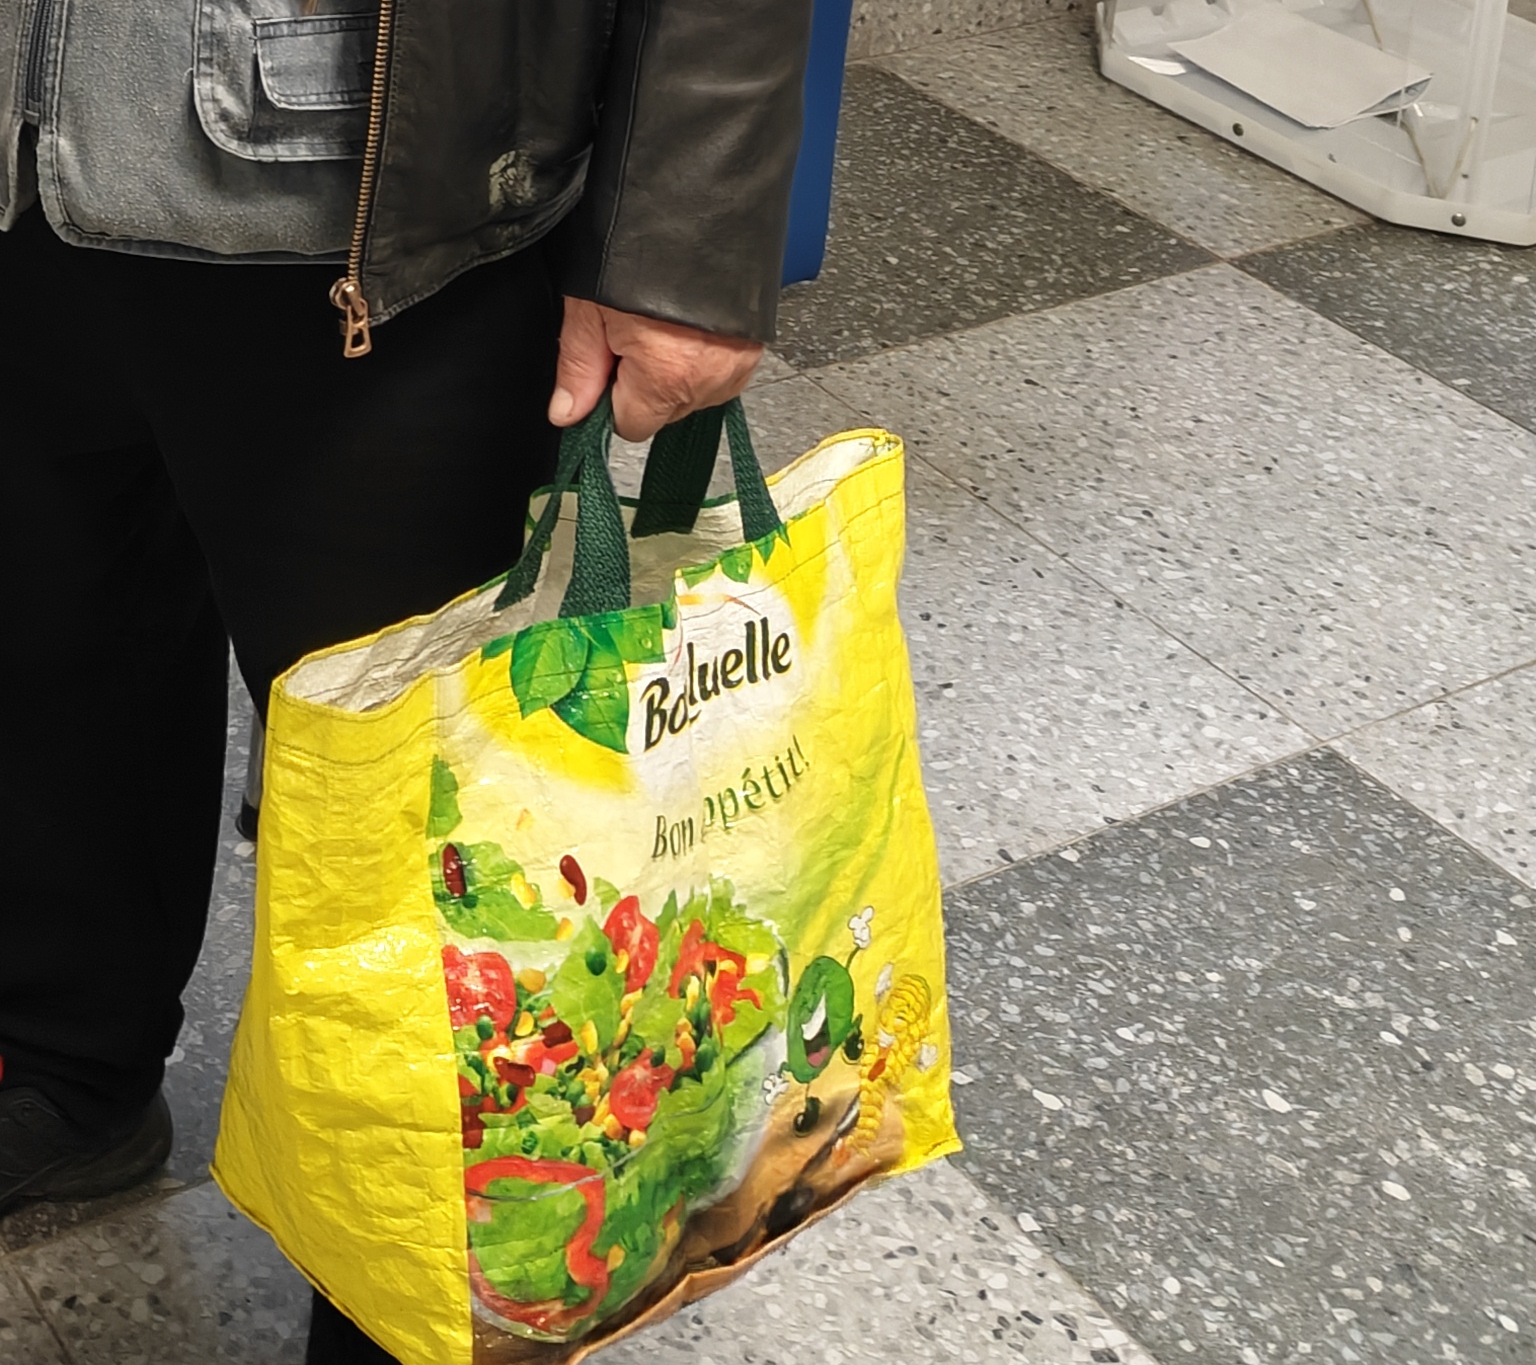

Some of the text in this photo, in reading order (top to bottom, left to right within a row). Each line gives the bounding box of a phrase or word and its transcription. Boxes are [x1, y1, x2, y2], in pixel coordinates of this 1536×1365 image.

[639, 616, 792, 752] Bouelle
[651, 734, 810, 859] Bon ppétit!
